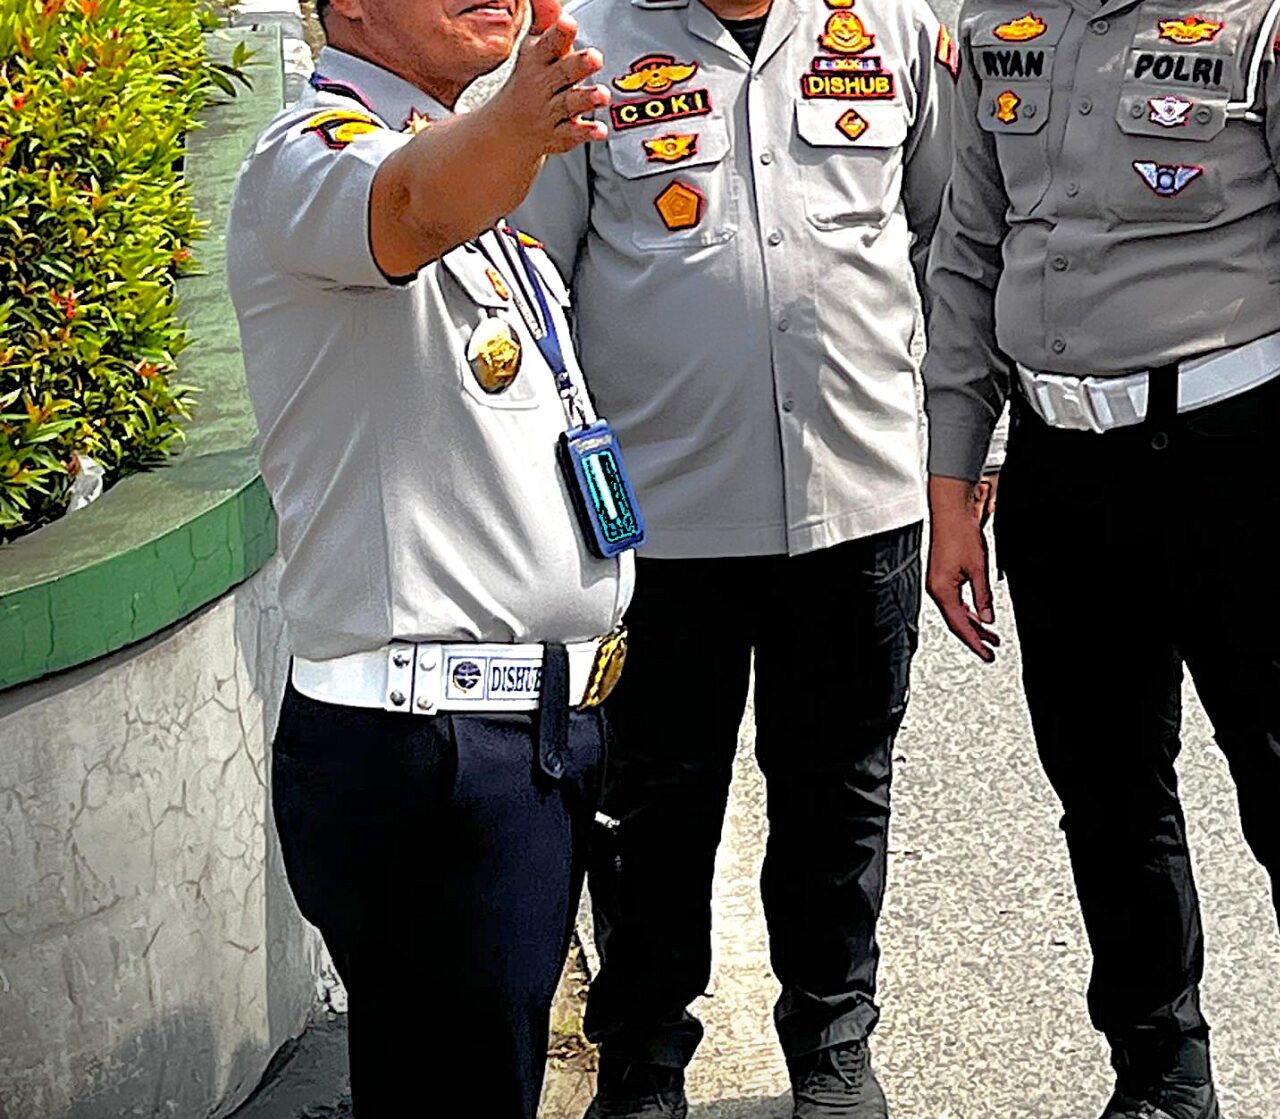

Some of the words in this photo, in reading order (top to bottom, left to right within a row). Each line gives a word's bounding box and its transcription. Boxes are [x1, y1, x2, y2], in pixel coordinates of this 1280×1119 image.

[982, 50, 1045, 78] RYAN
[1134, 54, 1224, 86] POLRI
[808, 76, 891, 95] DISHUB
[619, 92, 705, 124] COKI
